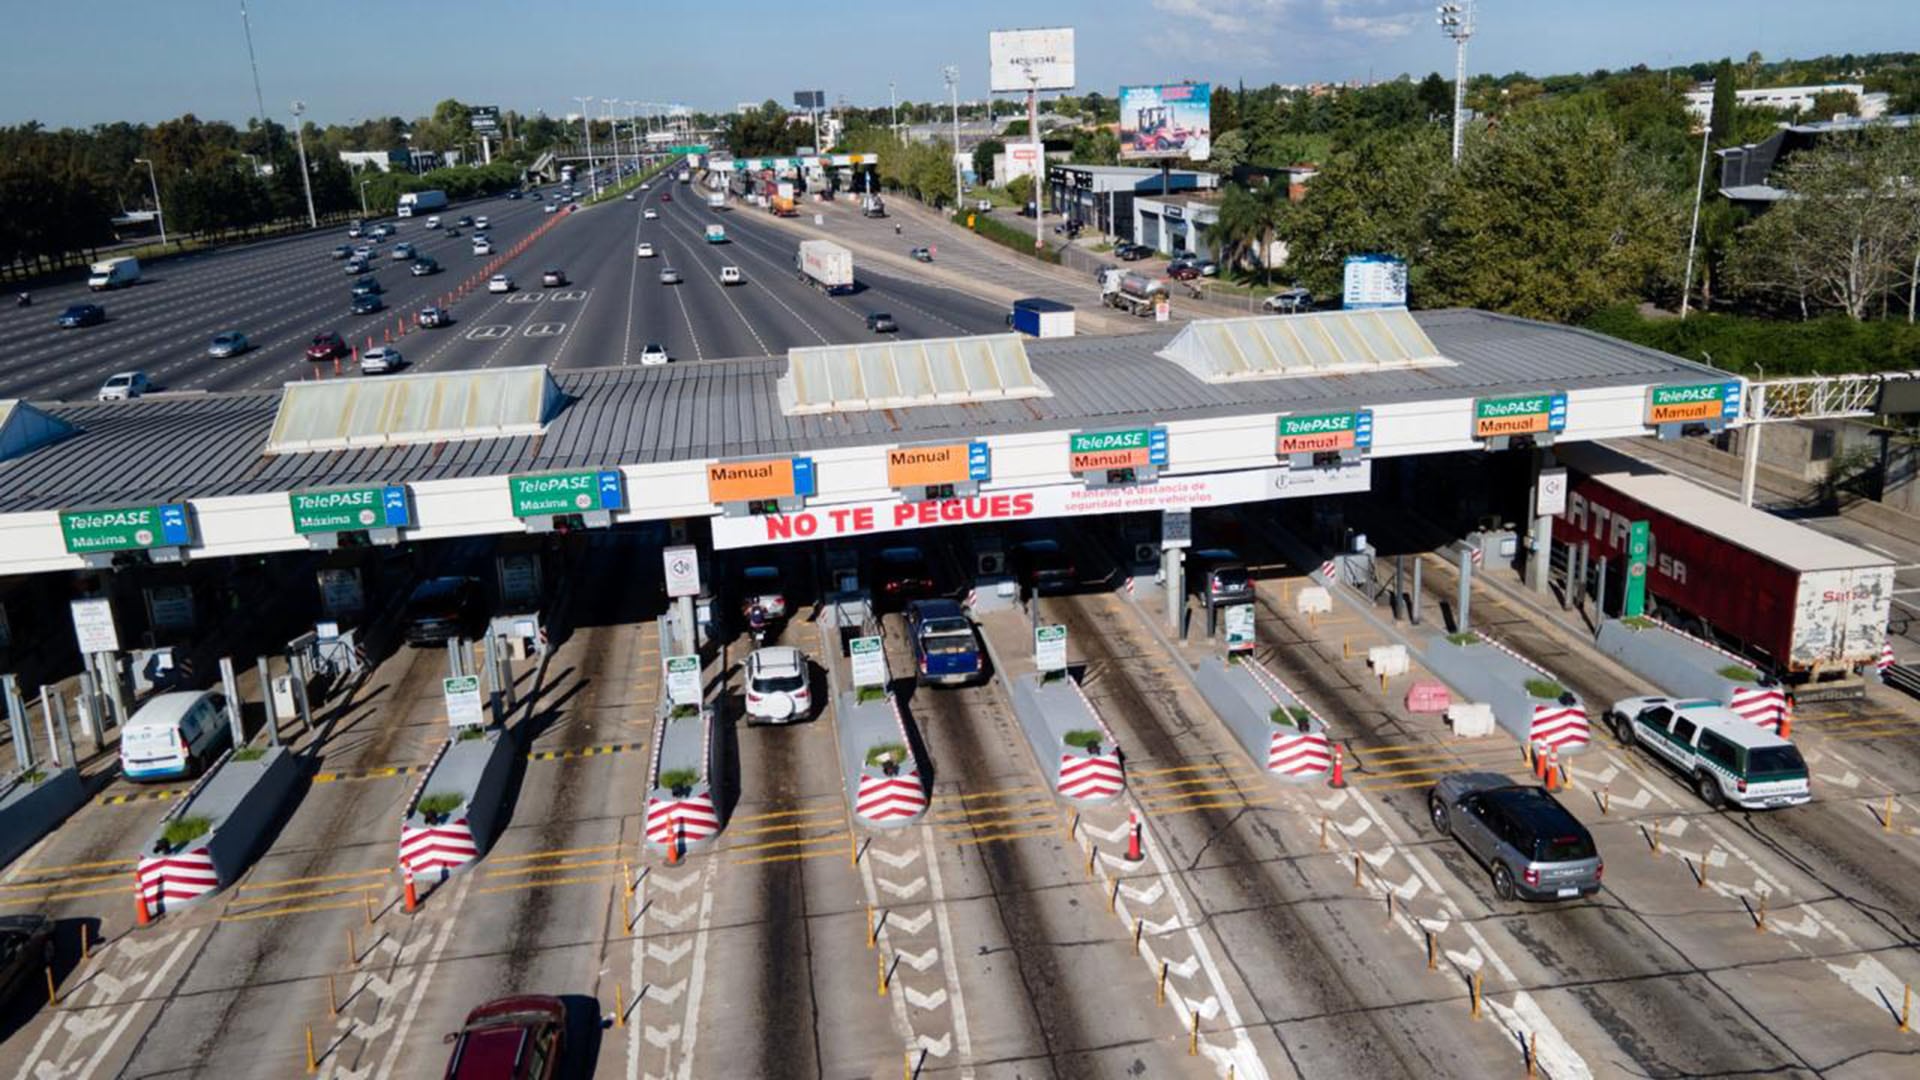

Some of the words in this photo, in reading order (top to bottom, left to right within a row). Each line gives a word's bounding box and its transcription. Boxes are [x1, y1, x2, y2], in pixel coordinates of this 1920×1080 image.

[1657, 386, 1717, 403] TelePASE
[1484, 398, 1543, 415] TelePASE
[1654, 404, 1707, 419] Manual
[1285, 416, 1351, 432] TelePASE
[1480, 418, 1534, 434] Manual
[1076, 432, 1144, 449] TelePASE
[1283, 436, 1338, 451] Manual
[891, 445, 950, 465] Manual
[1073, 453, 1132, 468] Manual
[711, 464, 773, 480] Manual
[518, 476, 591, 493] TelePASE
[1136, 483, 1188, 496] distancia
[1191, 482, 1206, 491] de
[297, 491, 374, 509] TelePASE
[1065, 498, 1122, 512] seguridad
[1124, 496, 1155, 507] entre
[68, 511, 150, 529] TelePASE
[767, 513, 816, 540] NO
[829, 507, 873, 532] TE
[893, 493, 1034, 526] PEGUES
[1659, 552, 1688, 585] SA
